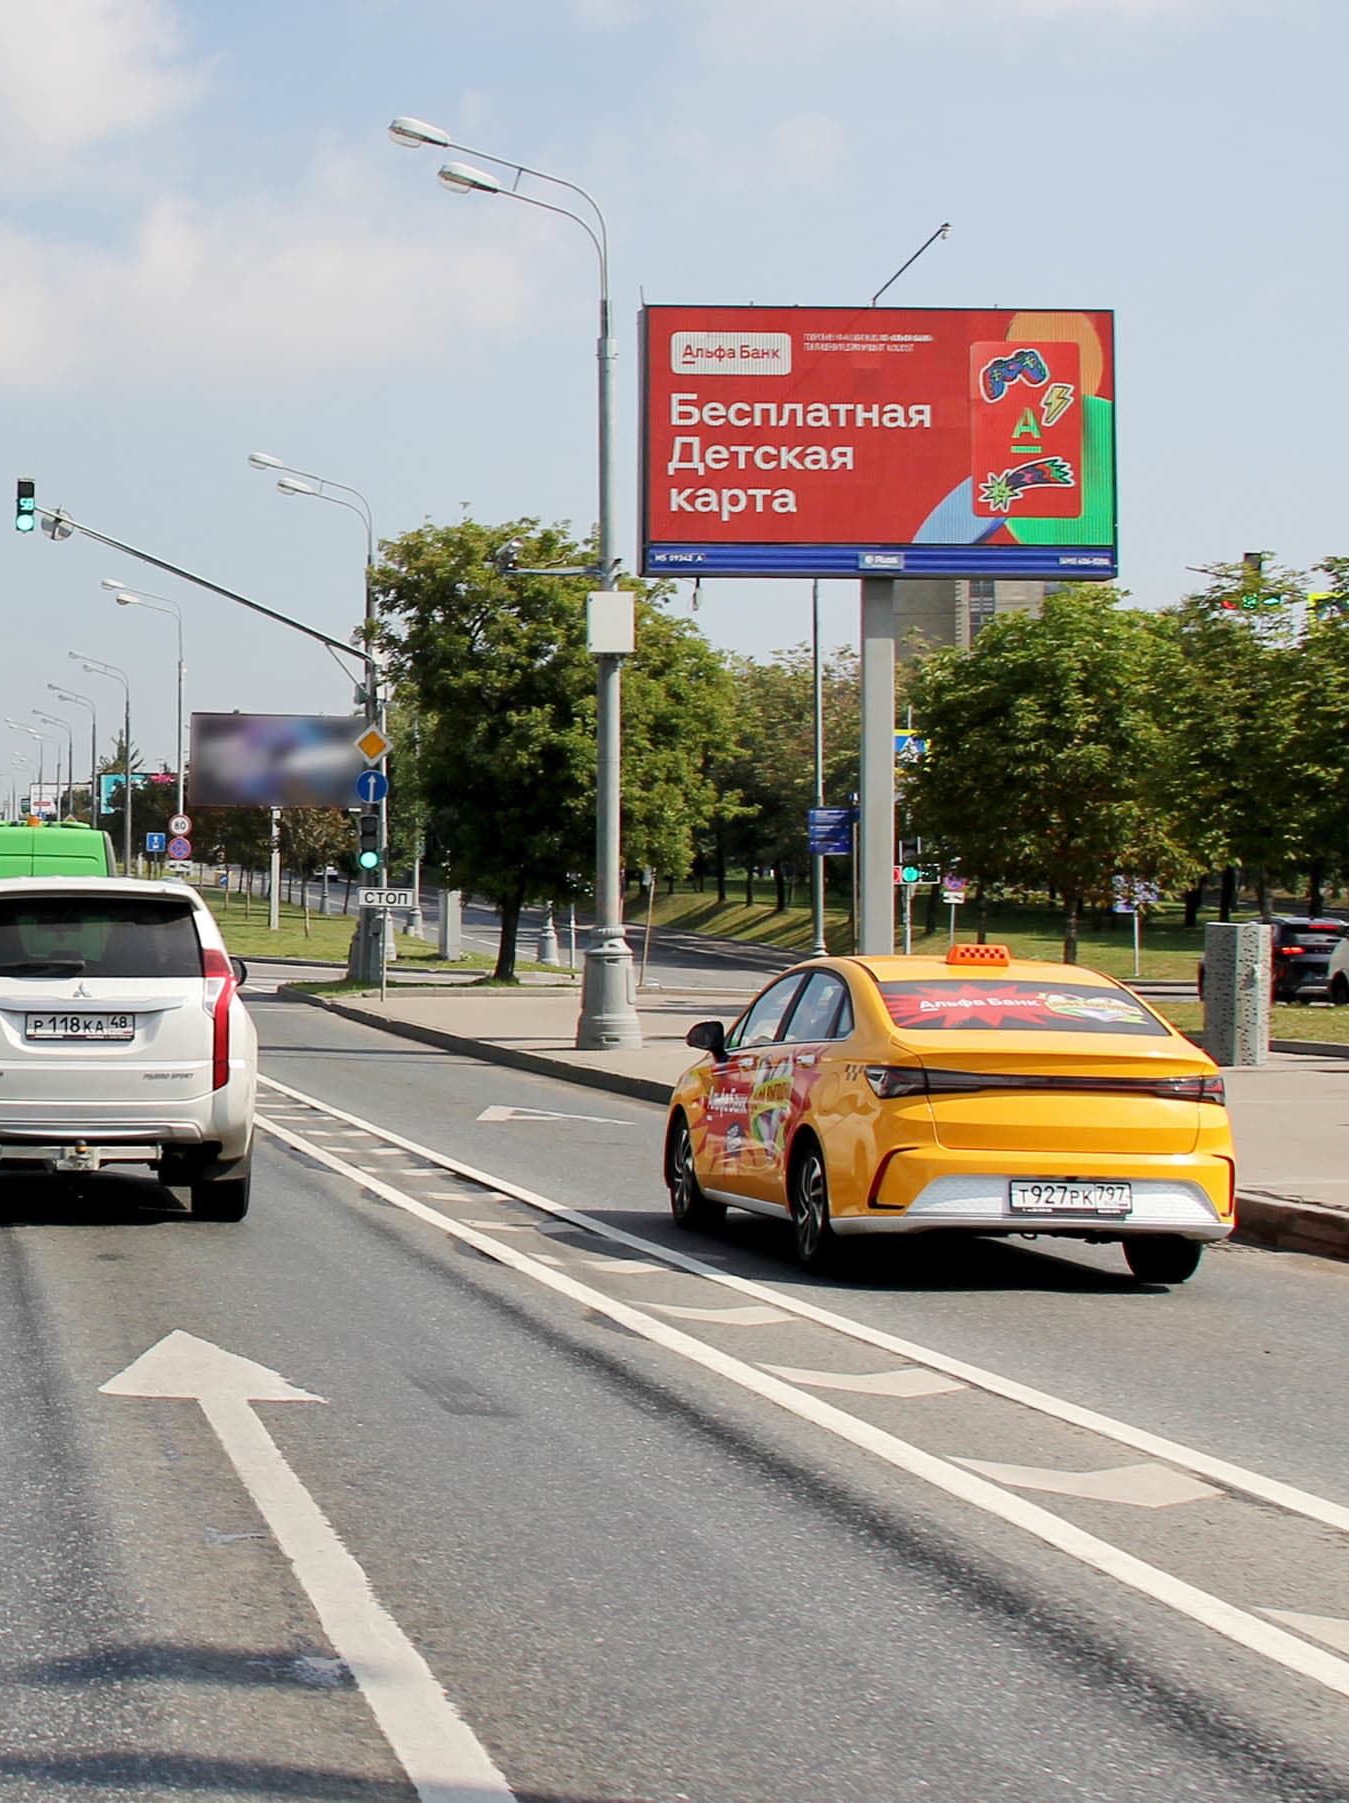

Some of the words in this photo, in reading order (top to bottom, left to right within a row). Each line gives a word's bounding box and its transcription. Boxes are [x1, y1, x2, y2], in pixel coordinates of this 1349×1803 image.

[682, 344, 736, 364] Альфа
[739, 345, 781, 359] Банк
[670, 392, 932, 429] Бесплатная
[667, 436, 854, 476] Детская
[669, 487, 798, 522] карта
[173, 821, 187, 831] 80
[364, 891, 408, 905] СТОП
[919, 996, 984, 1012] Альфа
[985, 996, 1041, 1007] Банк
[33, 1016, 105, 1034] Р118КА
[110, 1016, 128, 1029] 48
[1018, 1185, 1093, 1206] Т927РК
[1096, 1185, 1125, 1201] 797
